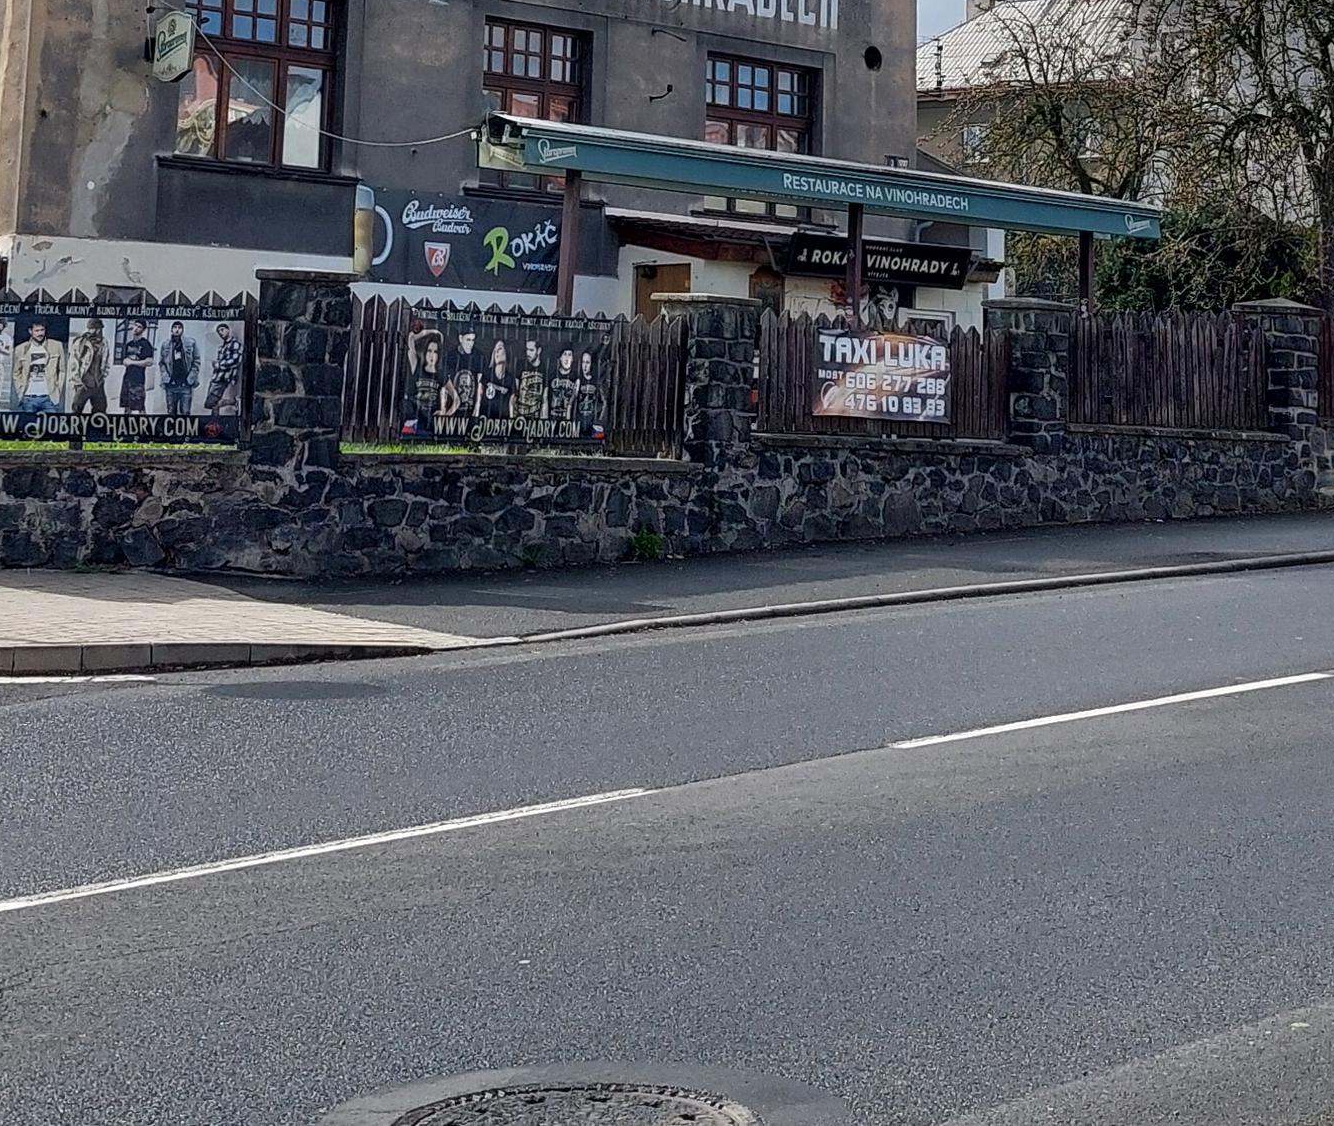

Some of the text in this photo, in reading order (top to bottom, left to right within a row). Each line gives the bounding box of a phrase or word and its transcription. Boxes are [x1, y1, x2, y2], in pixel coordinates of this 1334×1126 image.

[783, 173, 969, 211] RESTAURACE NA VINOHRADECH
[402, 200, 473, 226] Budweiser
[432, 220, 472, 235] Budvar
[867, 253, 950, 275] VINOHRADY
[819, 334, 946, 372] TAXI LUKA
[818, 369, 843, 380] MOST
[845, 372, 877, 391] 606
[881, 375, 912, 393] 277
[844, 393, 946, 417] 476 10 83 83
